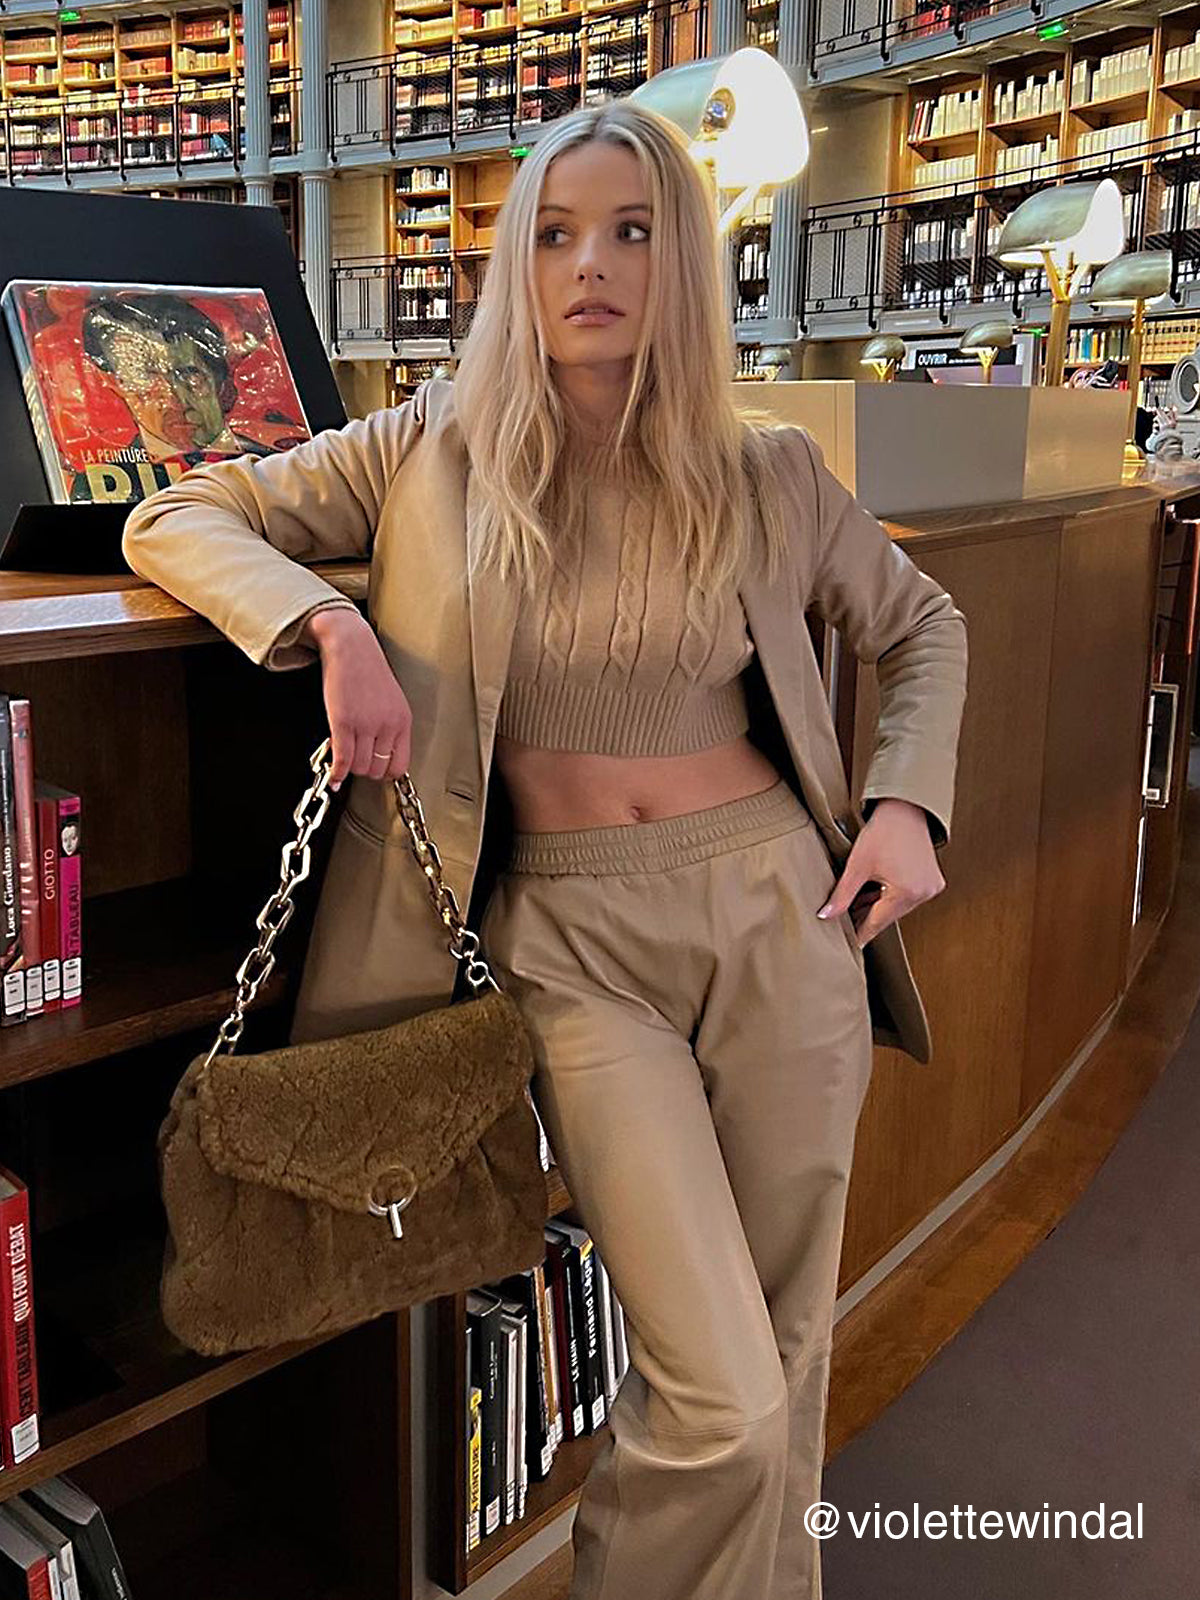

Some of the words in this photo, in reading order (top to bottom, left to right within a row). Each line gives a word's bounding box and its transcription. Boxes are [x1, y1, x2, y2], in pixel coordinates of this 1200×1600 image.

[80, 447, 96, 464] LA
[97, 446, 150, 464] PEINTURE
[2, 846, 14, 906] Giordano
[44, 848, 56, 900] GIOTTO
[5, 908, 16, 938] Luca
[68, 882, 80, 948] TABLEAU
[7, 1222, 26, 1266] DÉBAT
[12, 1263, 28, 1295] FONT
[13, 1295, 31, 1323] QUI
[586, 1297, 597, 1359] Fernand
[472, 1445, 480, 1502] PEINTURE
